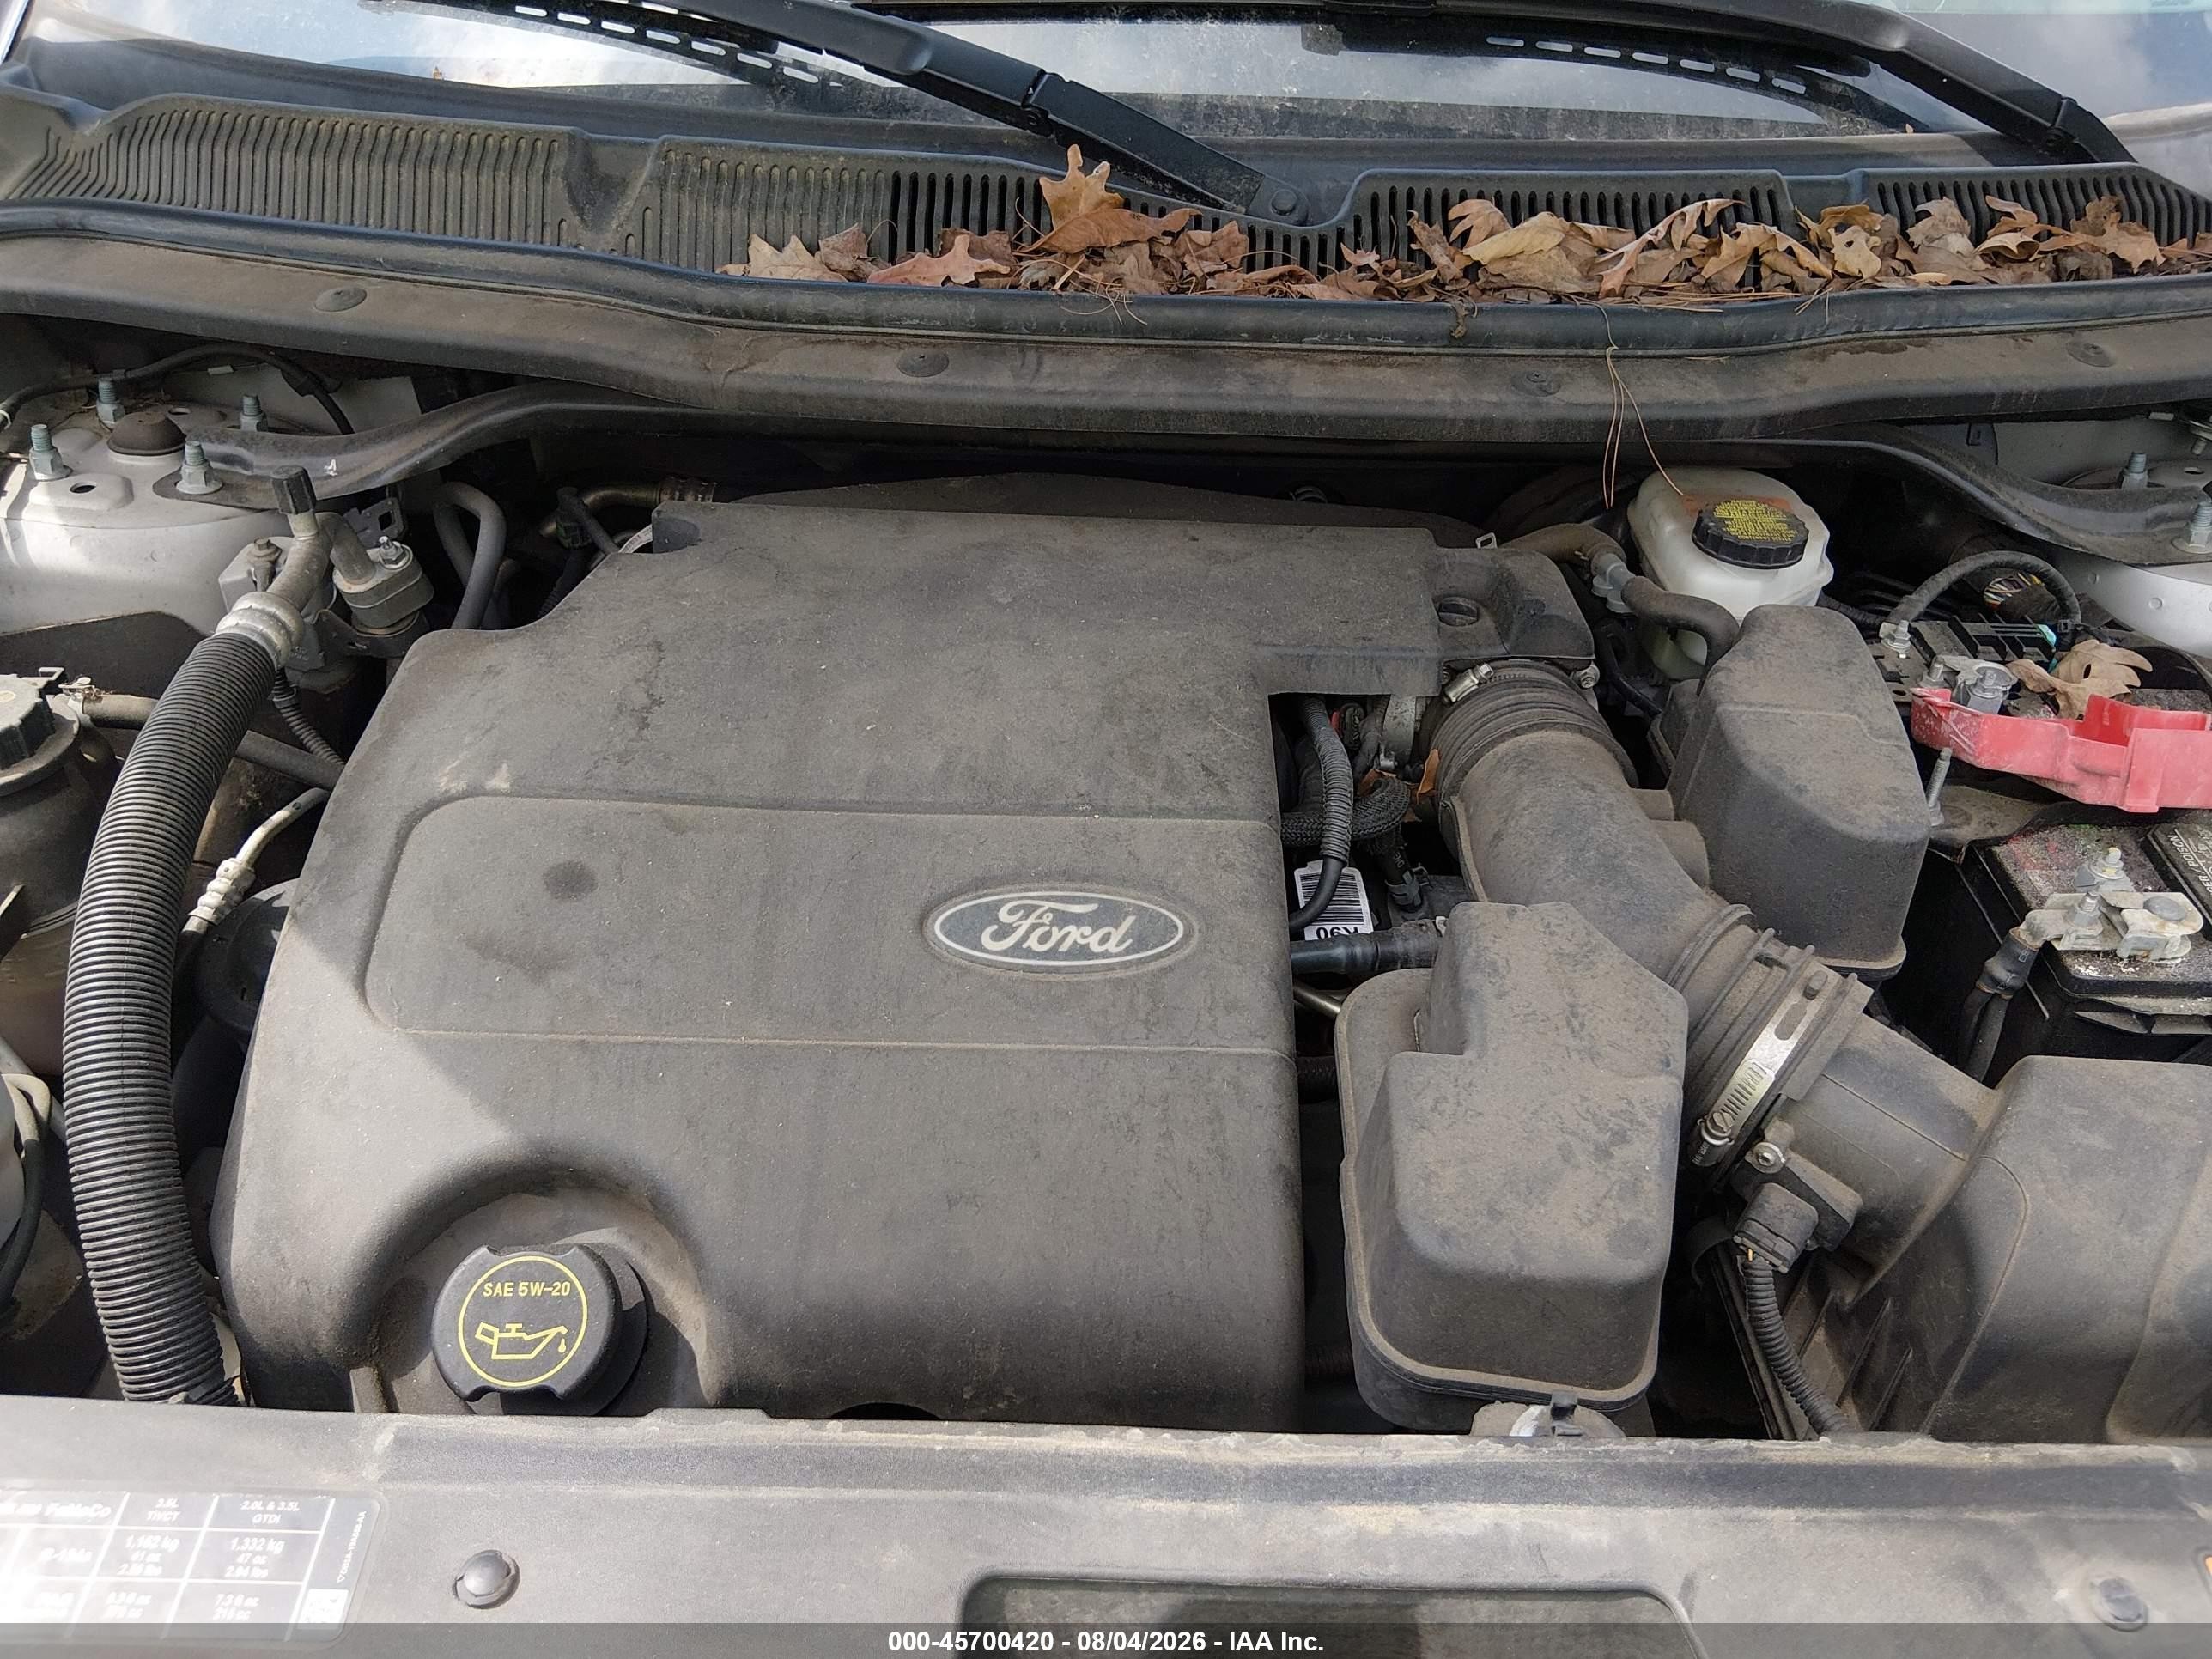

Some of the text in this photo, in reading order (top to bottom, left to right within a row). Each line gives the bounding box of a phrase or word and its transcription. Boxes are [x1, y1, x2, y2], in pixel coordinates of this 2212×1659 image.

[2167, 835, 2199, 866] POISON
[981, 899, 1137, 954] Ford
[483, 1280, 571, 1297] SAE 5W-20
[277, 1501, 300, 1511] 3.5L
[161, 1534, 180, 1553] kg
[266, 1538, 286, 1555] kg
